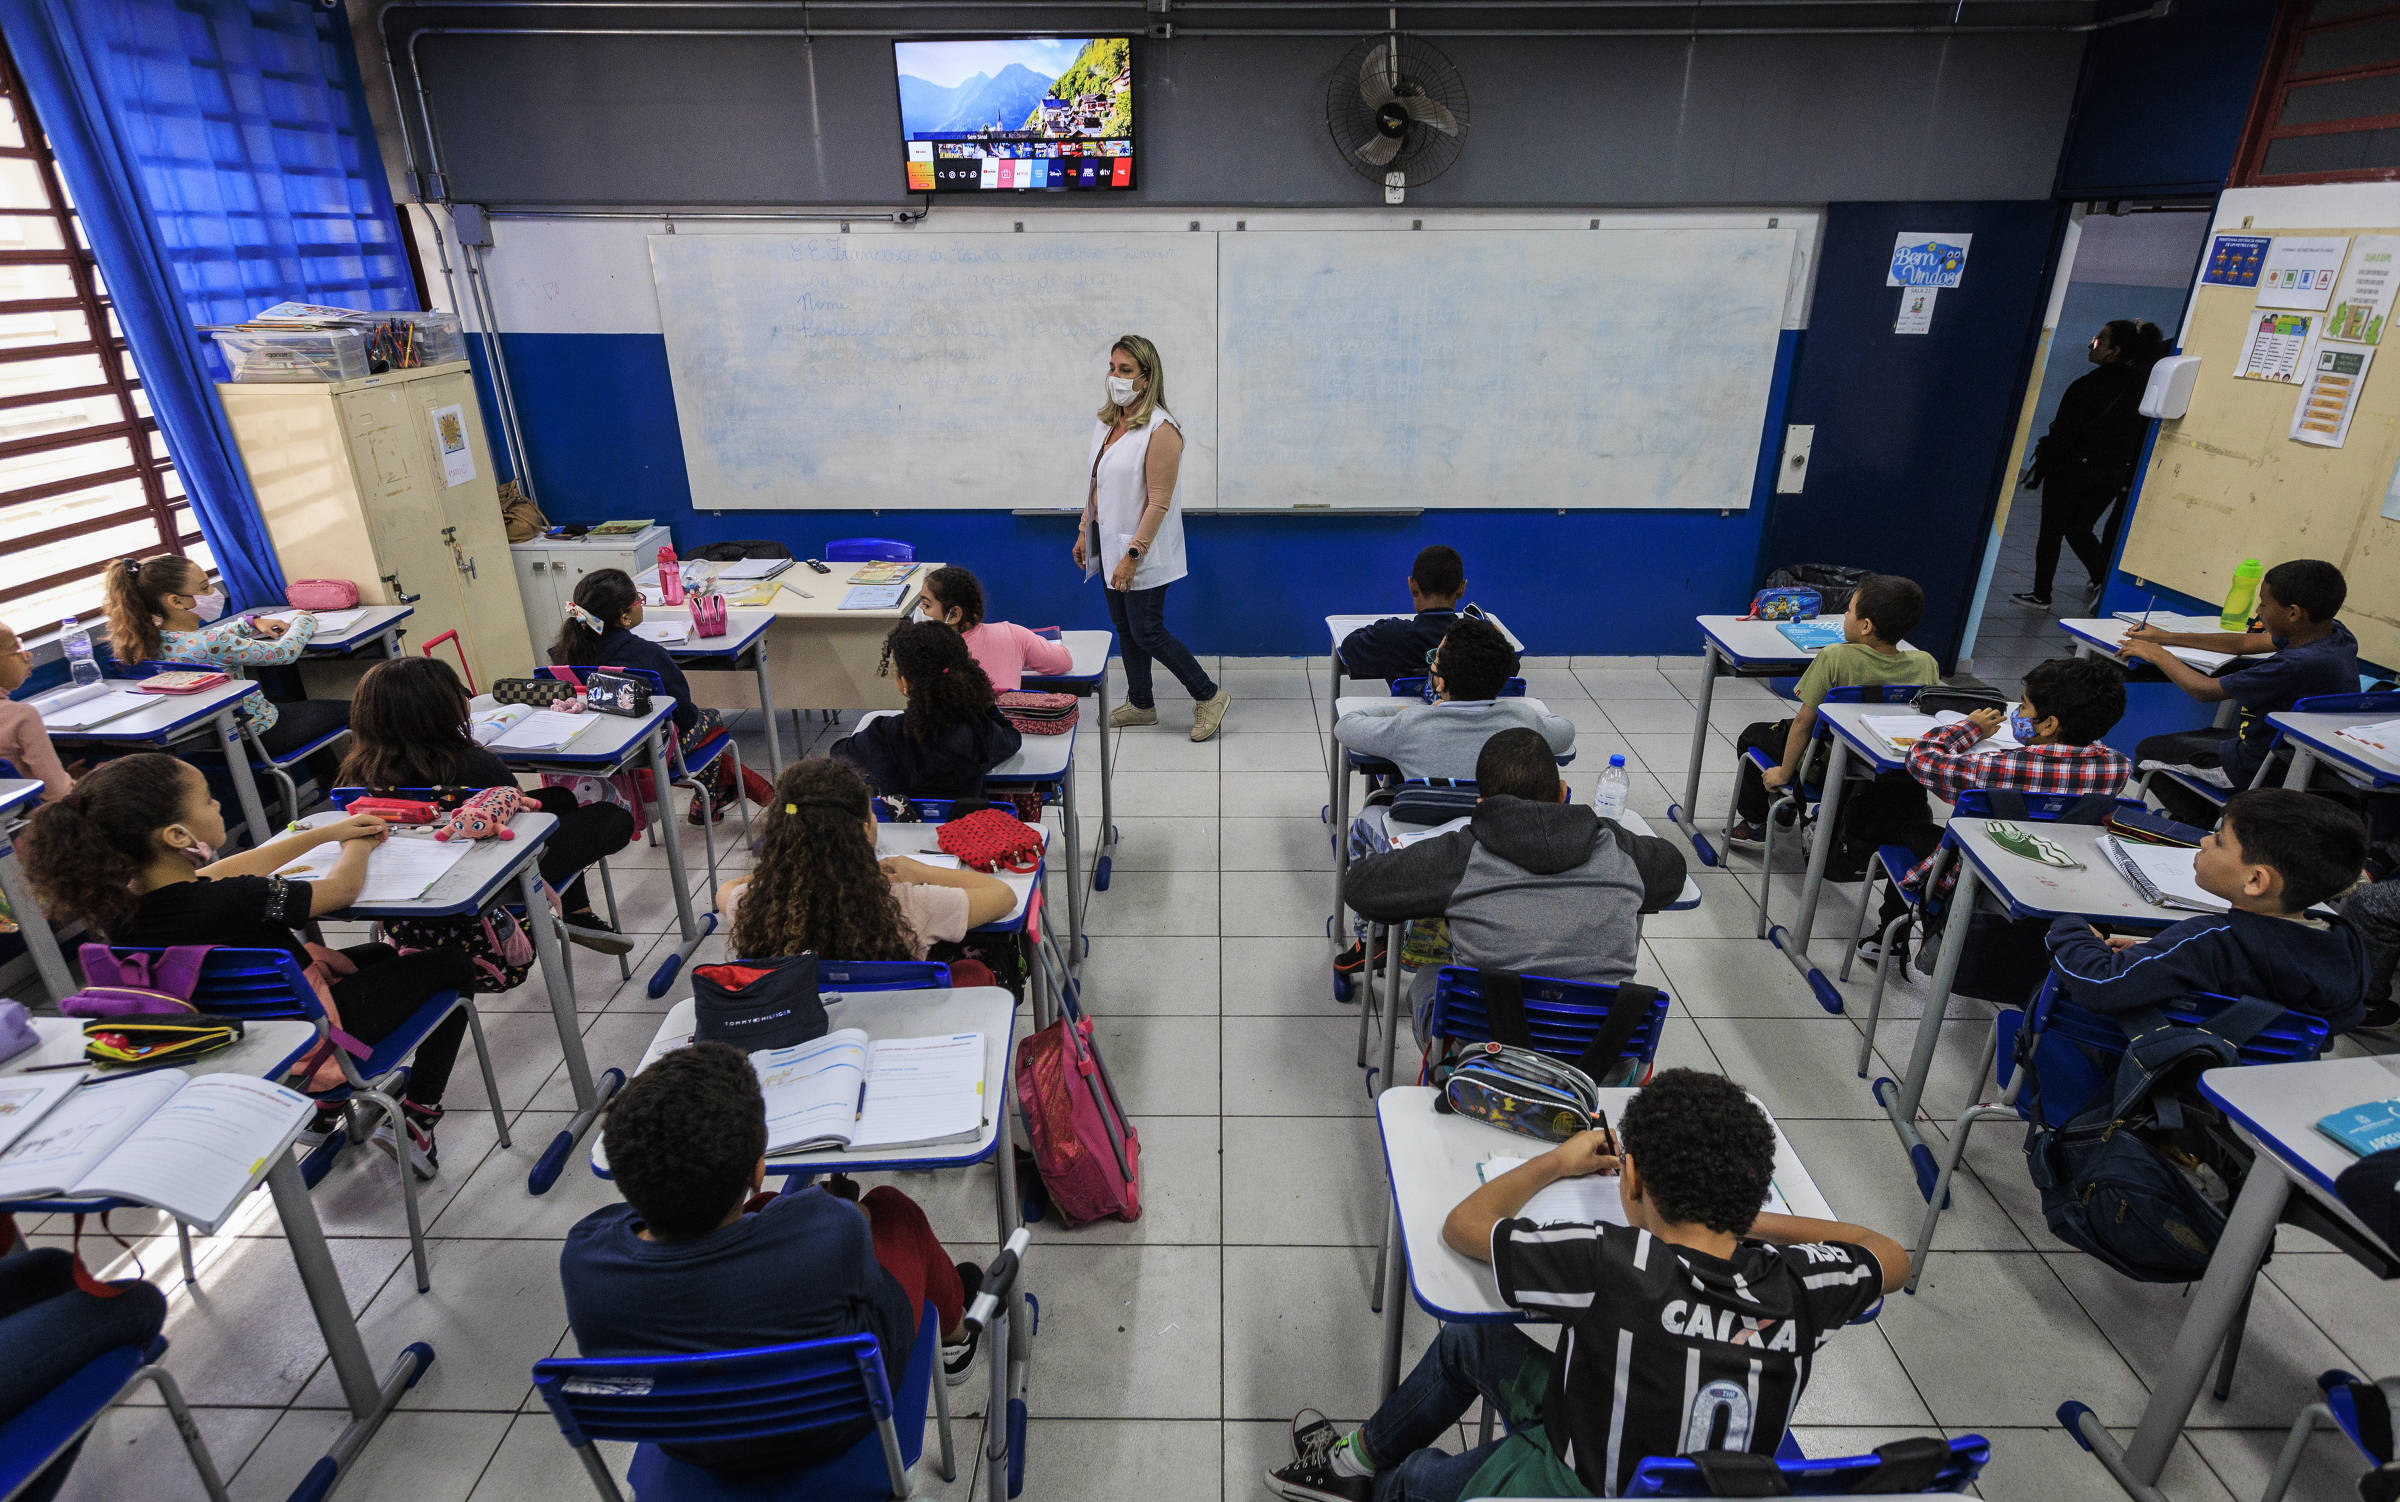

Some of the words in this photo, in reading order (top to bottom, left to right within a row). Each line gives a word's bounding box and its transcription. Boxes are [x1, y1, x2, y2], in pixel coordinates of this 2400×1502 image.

[1895, 247, 1938, 266] Bem
[1902, 265, 1957, 286] Vindos
[724, 1018, 752, 1027] TOMMY
[761, 1009, 791, 1022] HILFIGER
[1661, 1299, 1796, 1353] CAIXA
